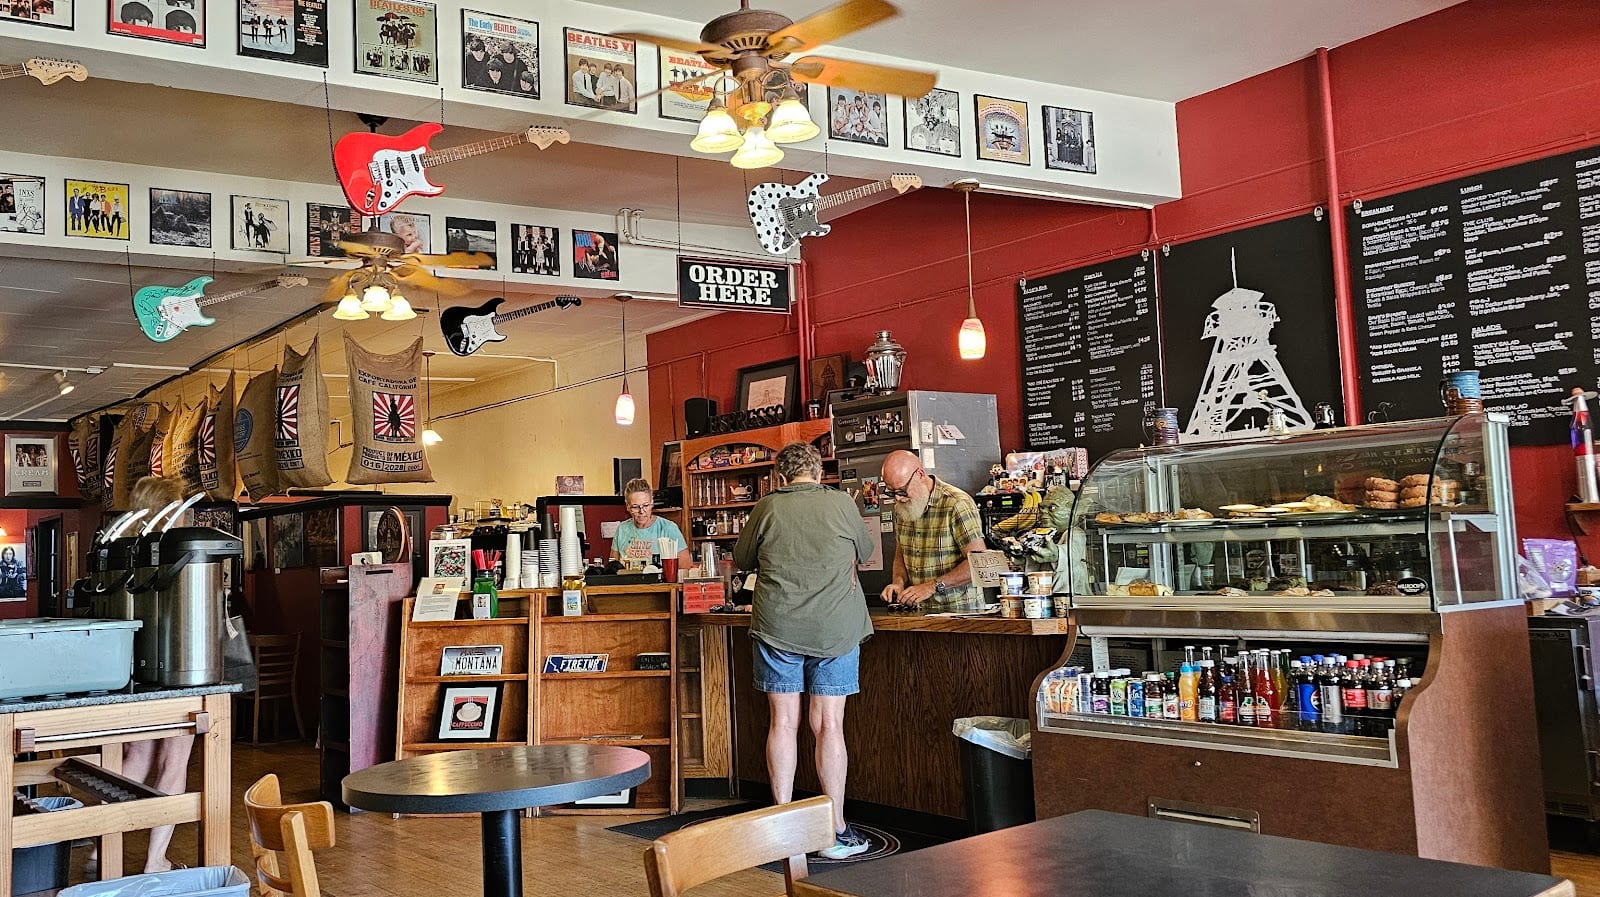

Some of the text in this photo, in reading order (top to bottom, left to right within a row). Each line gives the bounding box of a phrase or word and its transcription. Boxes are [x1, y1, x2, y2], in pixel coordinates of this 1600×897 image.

[368, 0, 409, 12] BEATLES
[468, 17, 517, 34] The Early BEATLES
[567, 32, 634, 52] BEATLES VI
[689, 264, 779, 288] ORDER
[698, 284, 771, 305] HERE
[408, 376, 417, 384] DE
[708, 404, 786, 433] ESPRESSO
[394, 450, 422, 461] MÉXICO
[363, 460, 382, 469] 016
[384, 463, 404, 471] 2028
[455, 656, 497, 670] MONTANA
[451, 721, 483, 729] CAPPUCCINO
